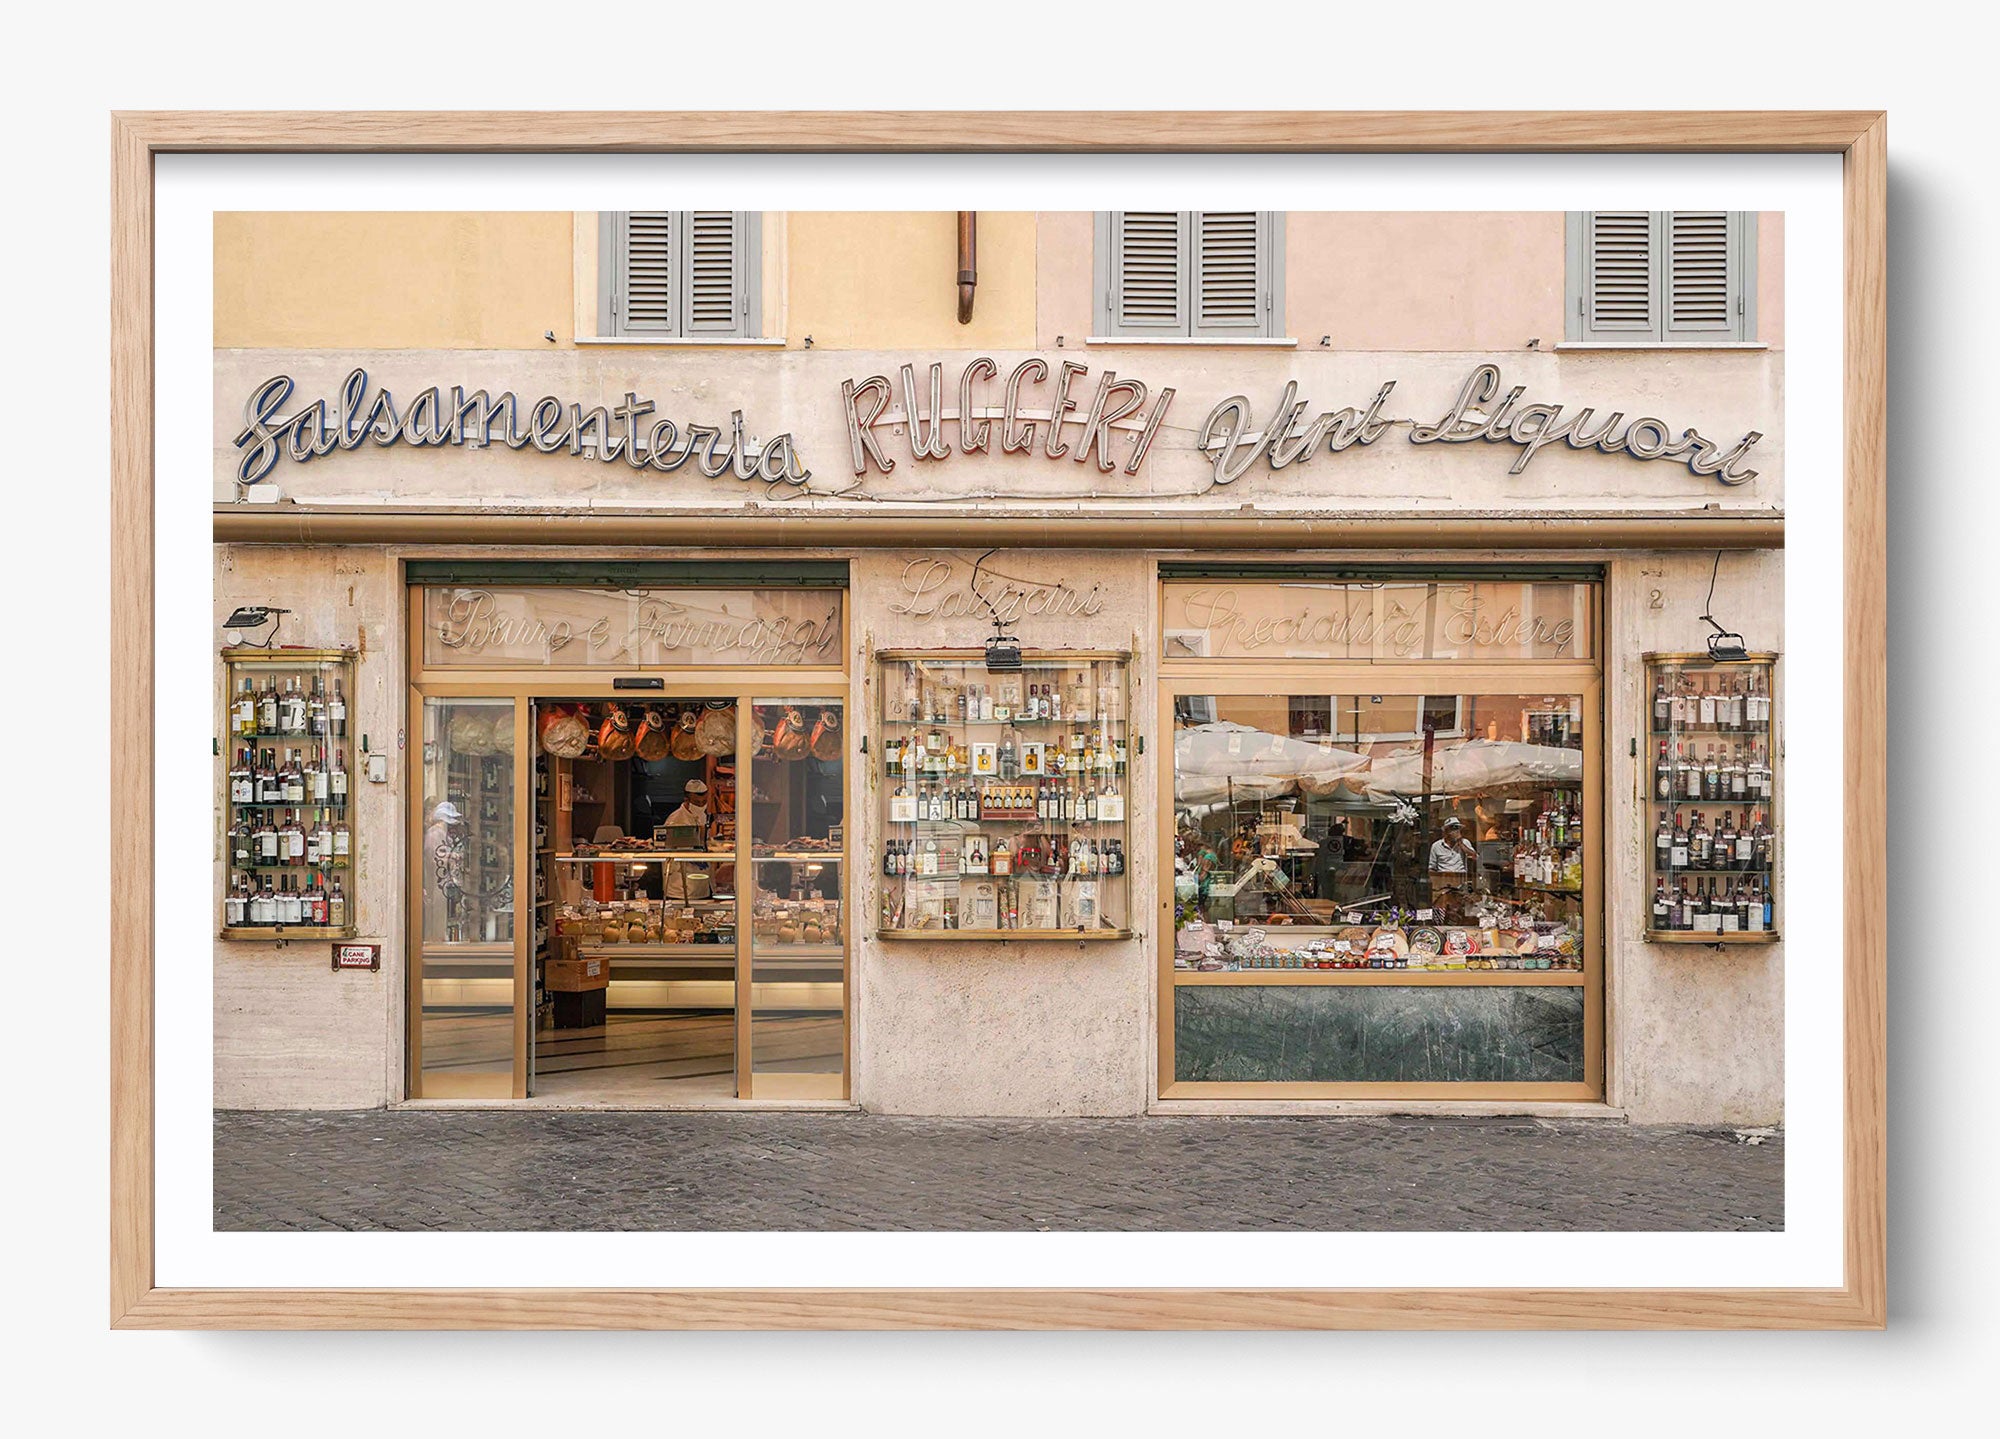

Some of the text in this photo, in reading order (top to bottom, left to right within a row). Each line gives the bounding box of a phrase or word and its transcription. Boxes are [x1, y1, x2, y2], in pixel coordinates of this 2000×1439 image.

[233, 357, 1763, 487] Salsamenteria RUGGERI Vini Liquori
[438, 590, 573, 652] Burro
[619, 597, 838, 664] Formaggi
[1443, 587, 1576, 652] Estere
[1650, 589, 1664, 609] 2
